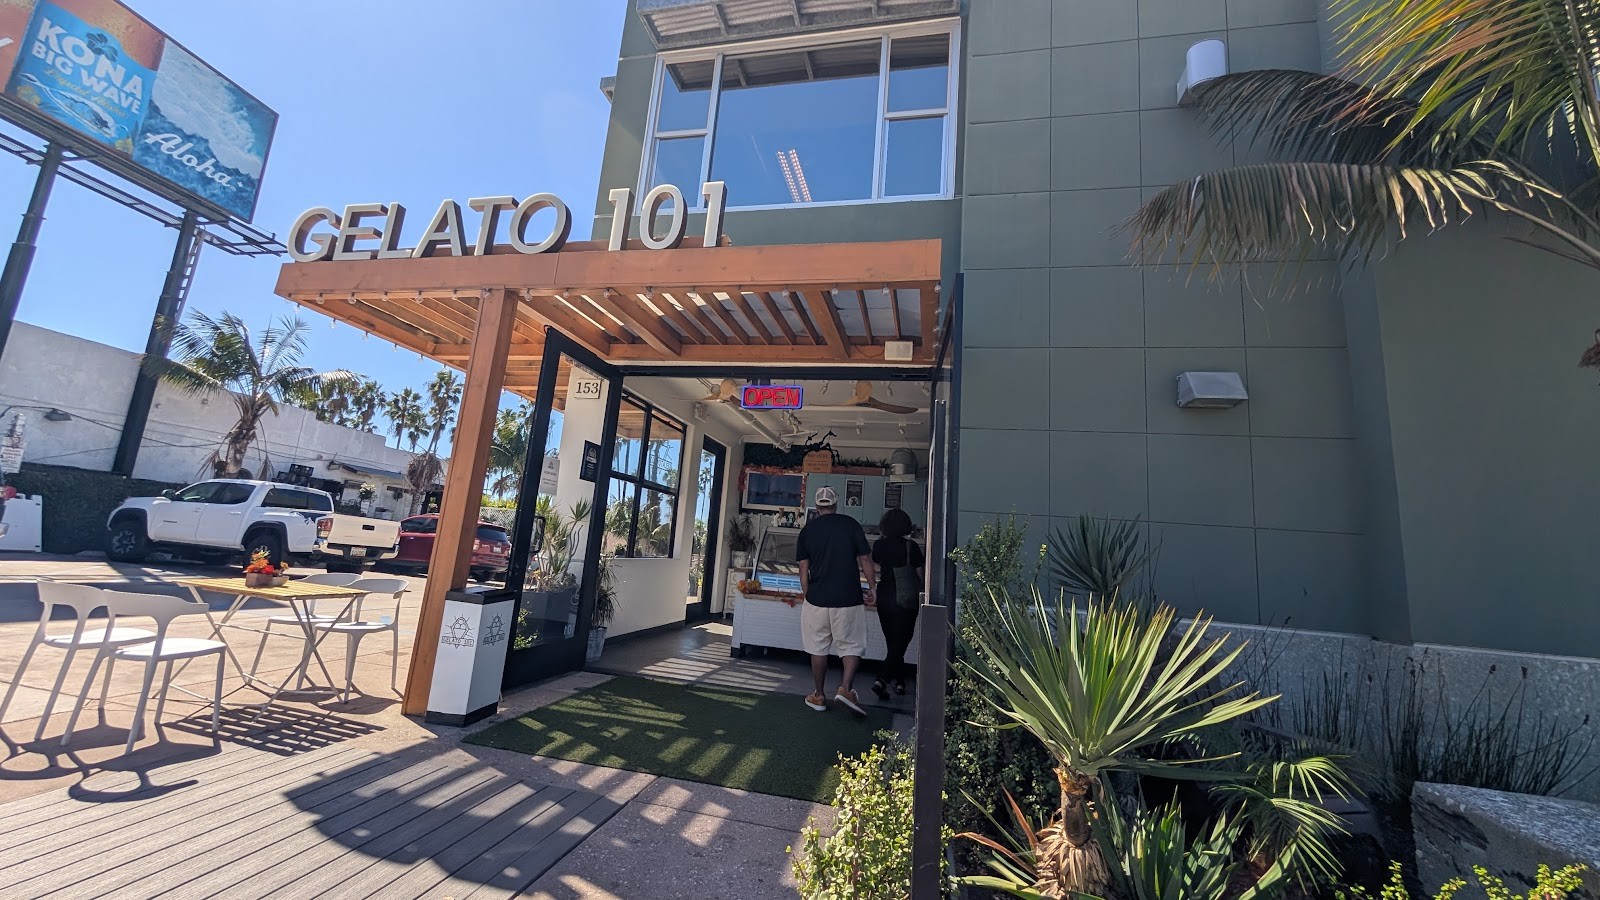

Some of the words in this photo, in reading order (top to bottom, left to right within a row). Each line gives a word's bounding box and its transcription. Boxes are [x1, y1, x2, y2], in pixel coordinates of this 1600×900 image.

[32, 40, 74, 75] BIG
[80, 67, 142, 115] WAVE
[38, 17, 143, 100] KONA
[286, 192, 571, 263] GELATO
[608, 181, 727, 252] 101
[575, 381, 599, 394] 153
[744, 387, 799, 407] OPEN
